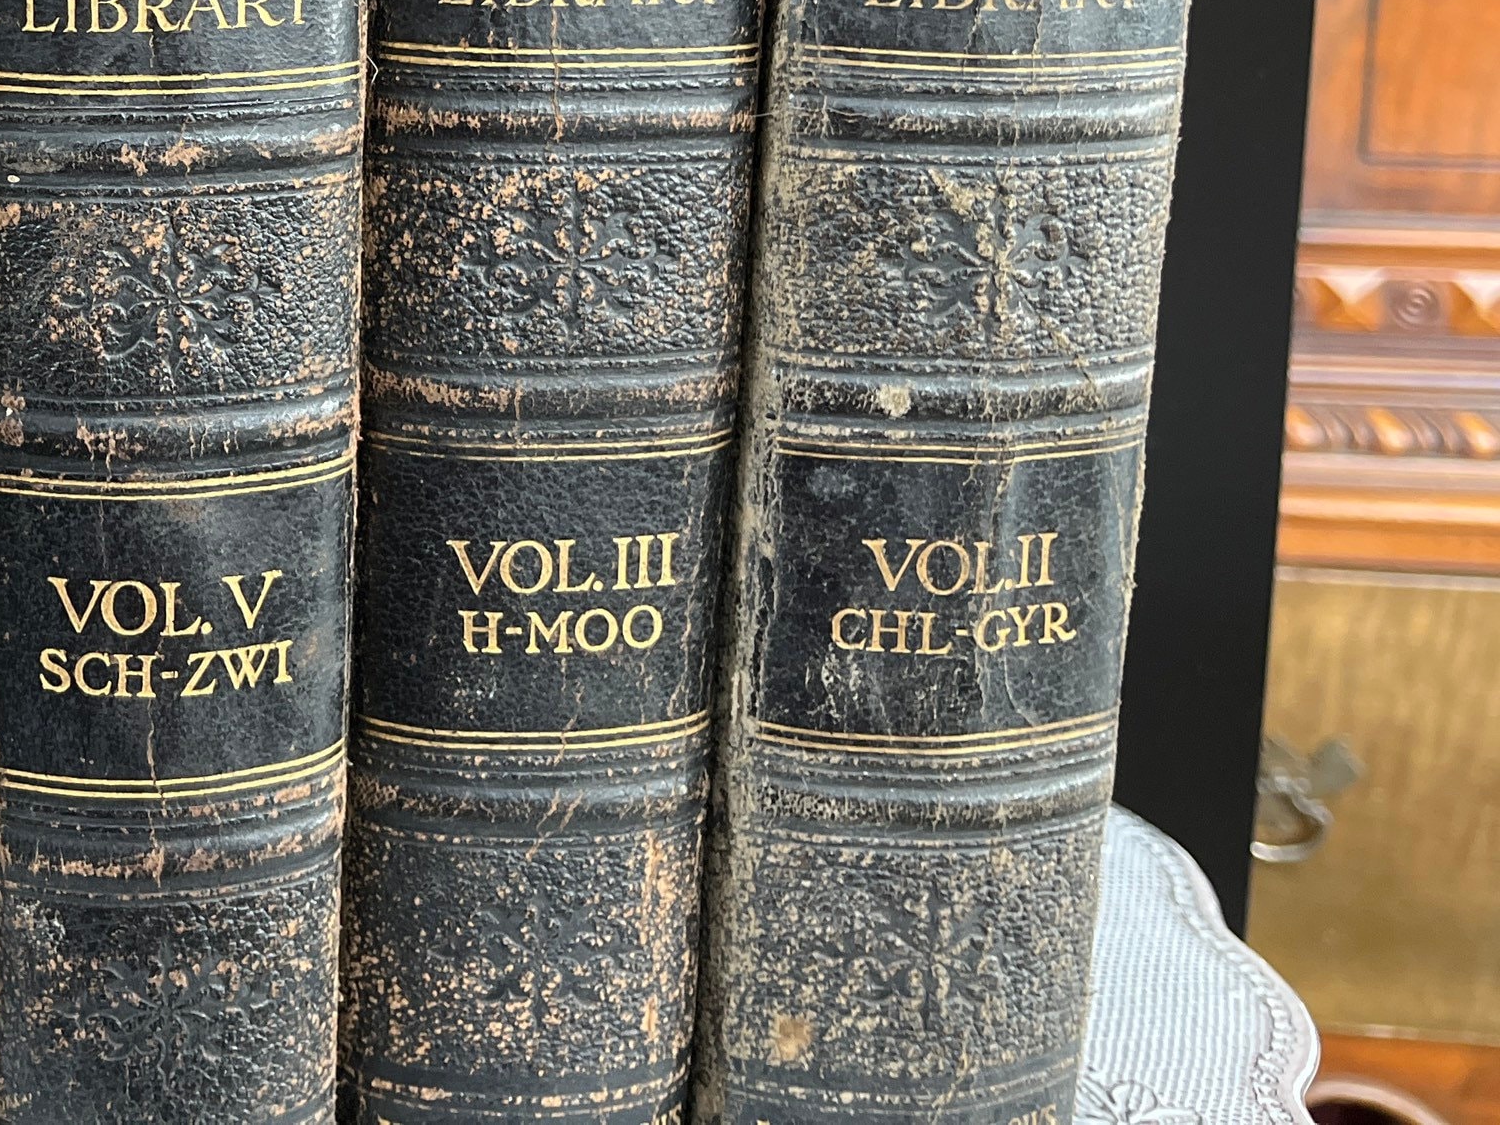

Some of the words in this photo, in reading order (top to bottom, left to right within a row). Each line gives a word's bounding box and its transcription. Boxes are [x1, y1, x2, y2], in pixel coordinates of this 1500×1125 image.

[47, 576, 213, 637] VOL.
[222, 569, 282, 629] V
[457, 604, 663, 654] H-MOO
[831, 602, 1077, 655] CHL-GYR
[39, 639, 293, 698] SCH-ZWI
